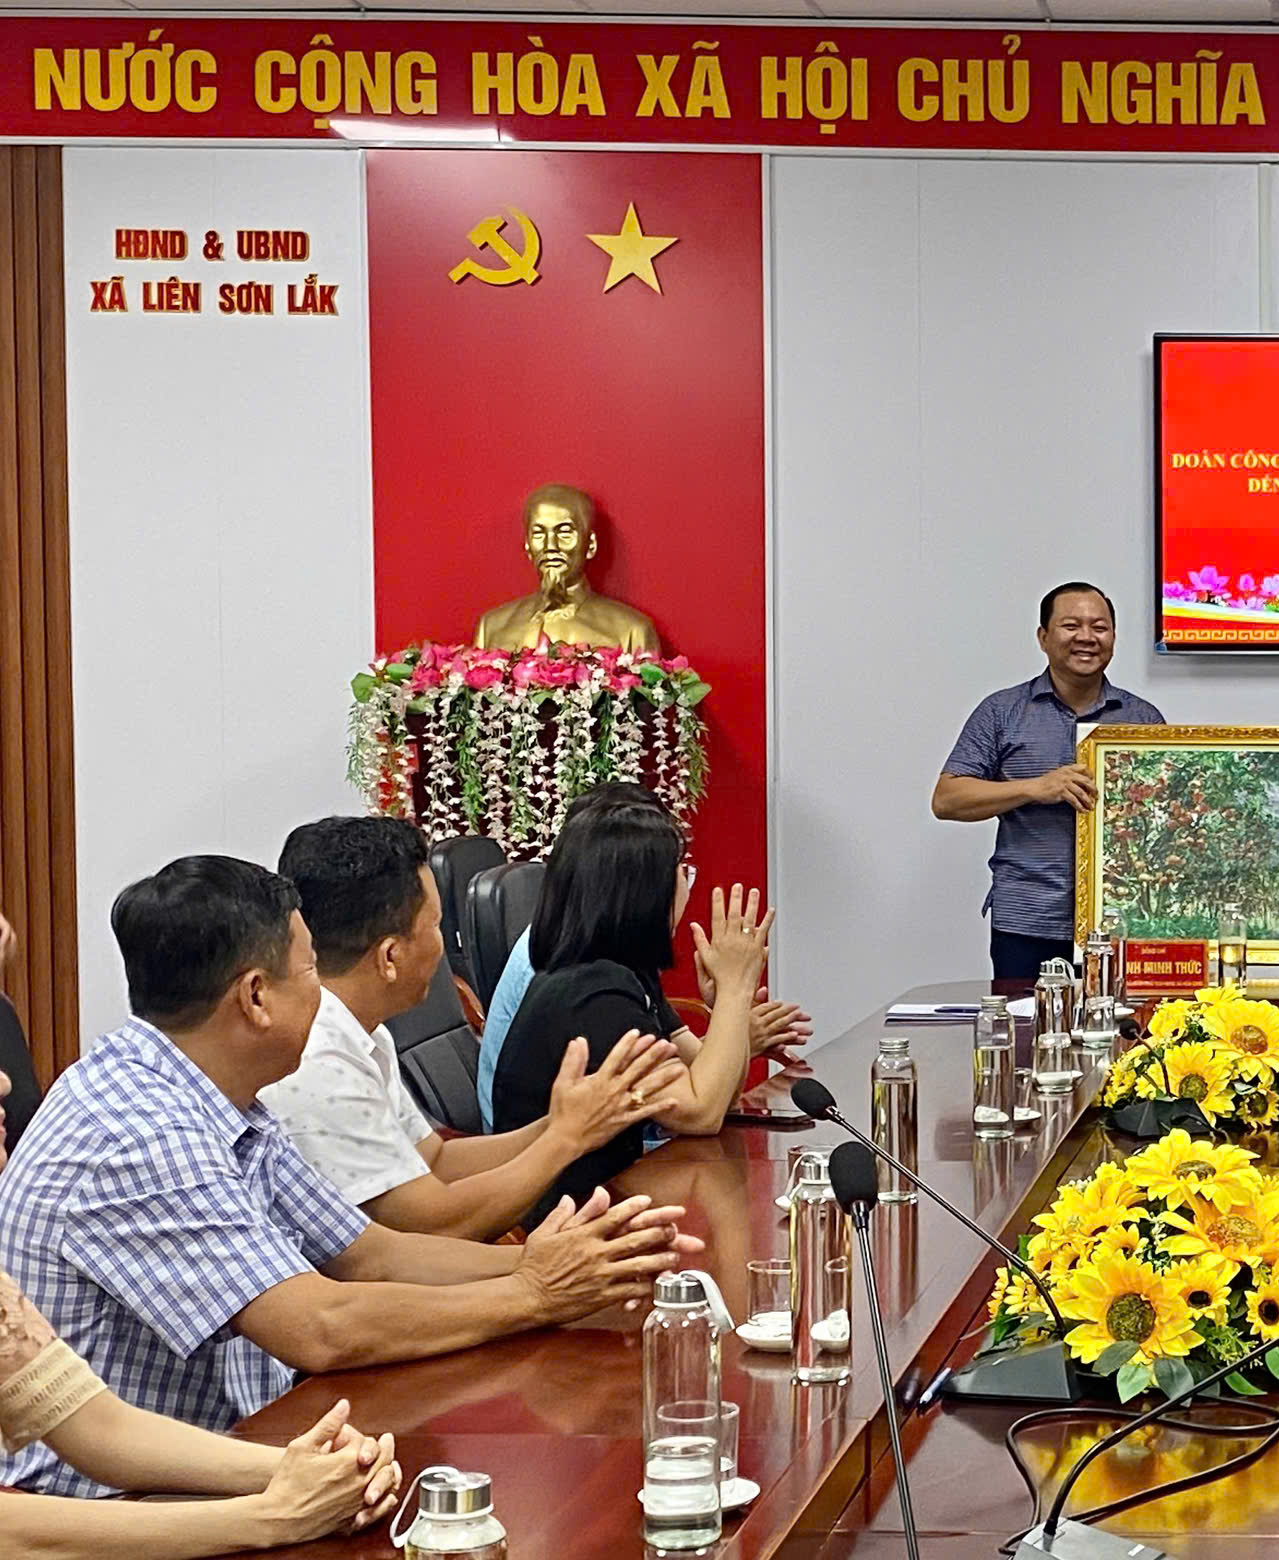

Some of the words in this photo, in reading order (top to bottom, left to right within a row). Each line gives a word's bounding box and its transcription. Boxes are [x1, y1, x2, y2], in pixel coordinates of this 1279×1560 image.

[34, 30, 217, 113] NƯỚC
[254, 34, 438, 129] CỘNG
[472, 36, 606, 116] HÒA
[637, 40, 731, 119] XÃ
[761, 42, 868, 134] HỘI
[897, 35, 1030, 124] CHỦ
[1061, 50, 1265, 126] NGHĨA
[115, 228, 188, 262] HĐND
[203, 230, 225, 262] &
[237, 230, 310, 262] UBND
[90, 276, 128, 313] XÃ
[142, 276, 201, 313] LIÊN
[219, 281, 274, 315] SƠN
[287, 274, 339, 316] LẮK
[1143, 961, 1173, 975] MINH
